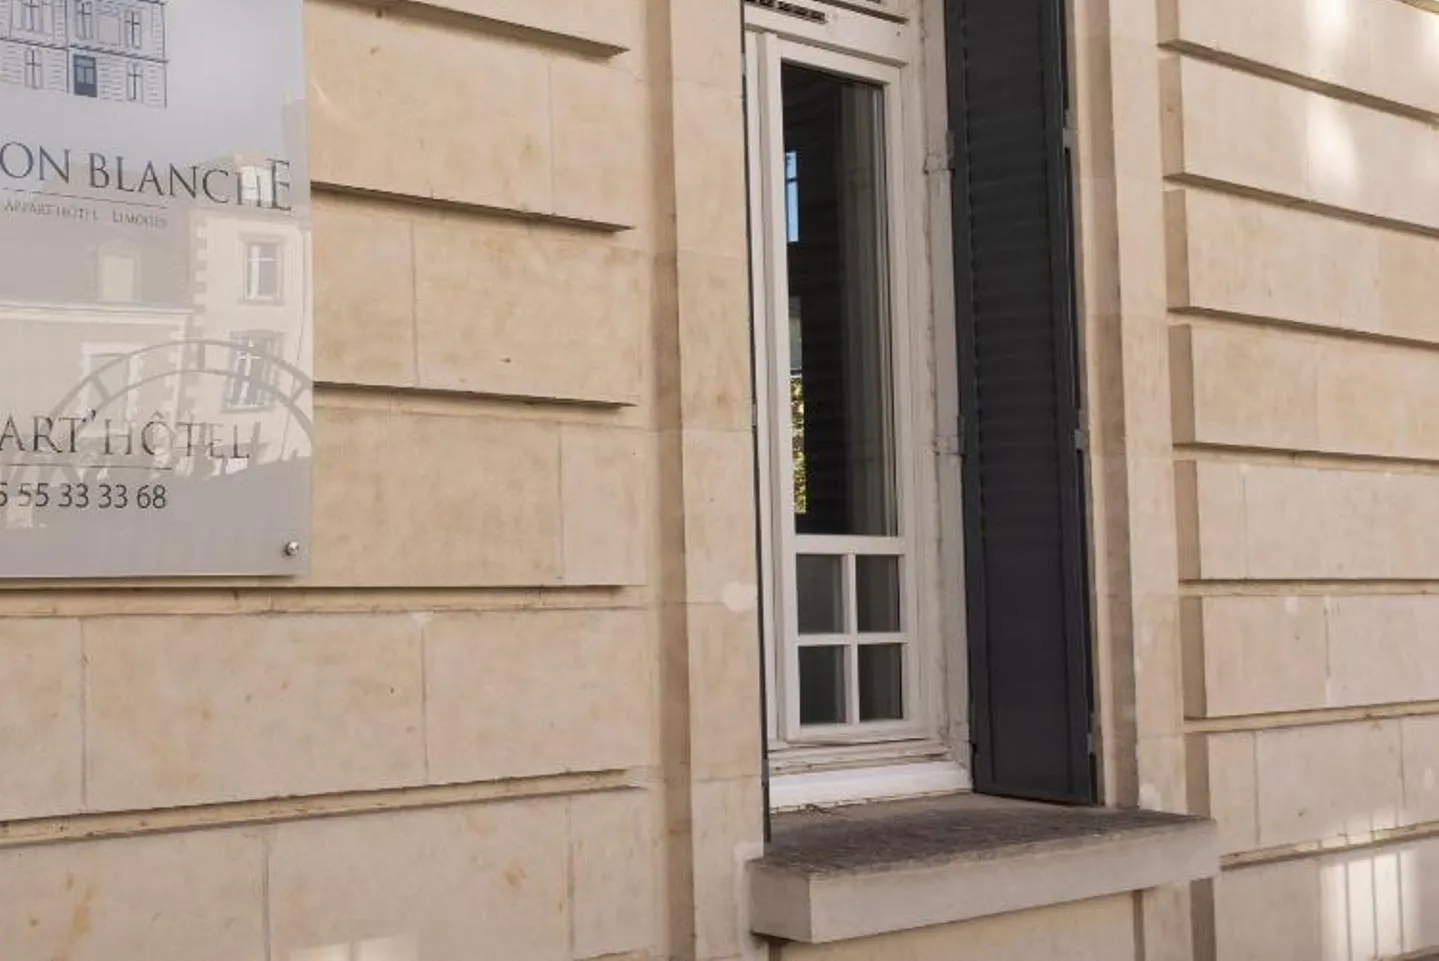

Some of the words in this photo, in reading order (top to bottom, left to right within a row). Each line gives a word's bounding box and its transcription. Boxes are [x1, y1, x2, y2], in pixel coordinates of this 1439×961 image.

[88, 151, 293, 211] BLANCHE
[17, 481, 49, 508] 55
[58, 483, 90, 508] 33
[98, 483, 128, 509] 33
[136, 483, 168, 510] 68
